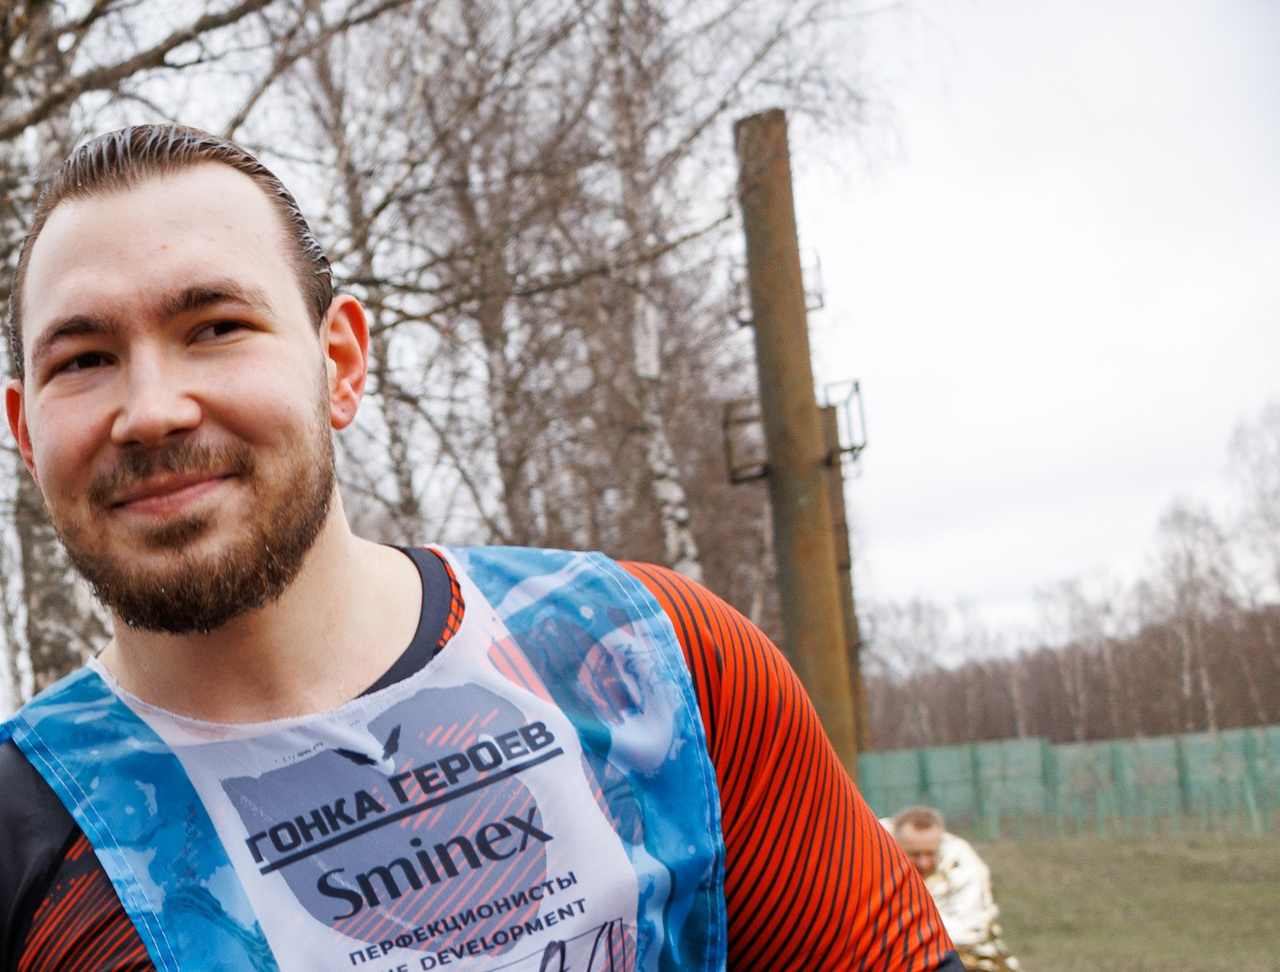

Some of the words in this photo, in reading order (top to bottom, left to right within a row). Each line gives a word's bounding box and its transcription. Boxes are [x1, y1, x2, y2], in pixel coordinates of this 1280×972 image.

[245, 790, 385, 863] ГОНКА
[388, 720, 556, 804] ГЕРОЕВ
[316, 806, 554, 921] Sminex
[349, 871, 578, 966] ПЕРФЕКЦИОНИСТЫ
[420, 898, 587, 972] DEVELOPMENT
